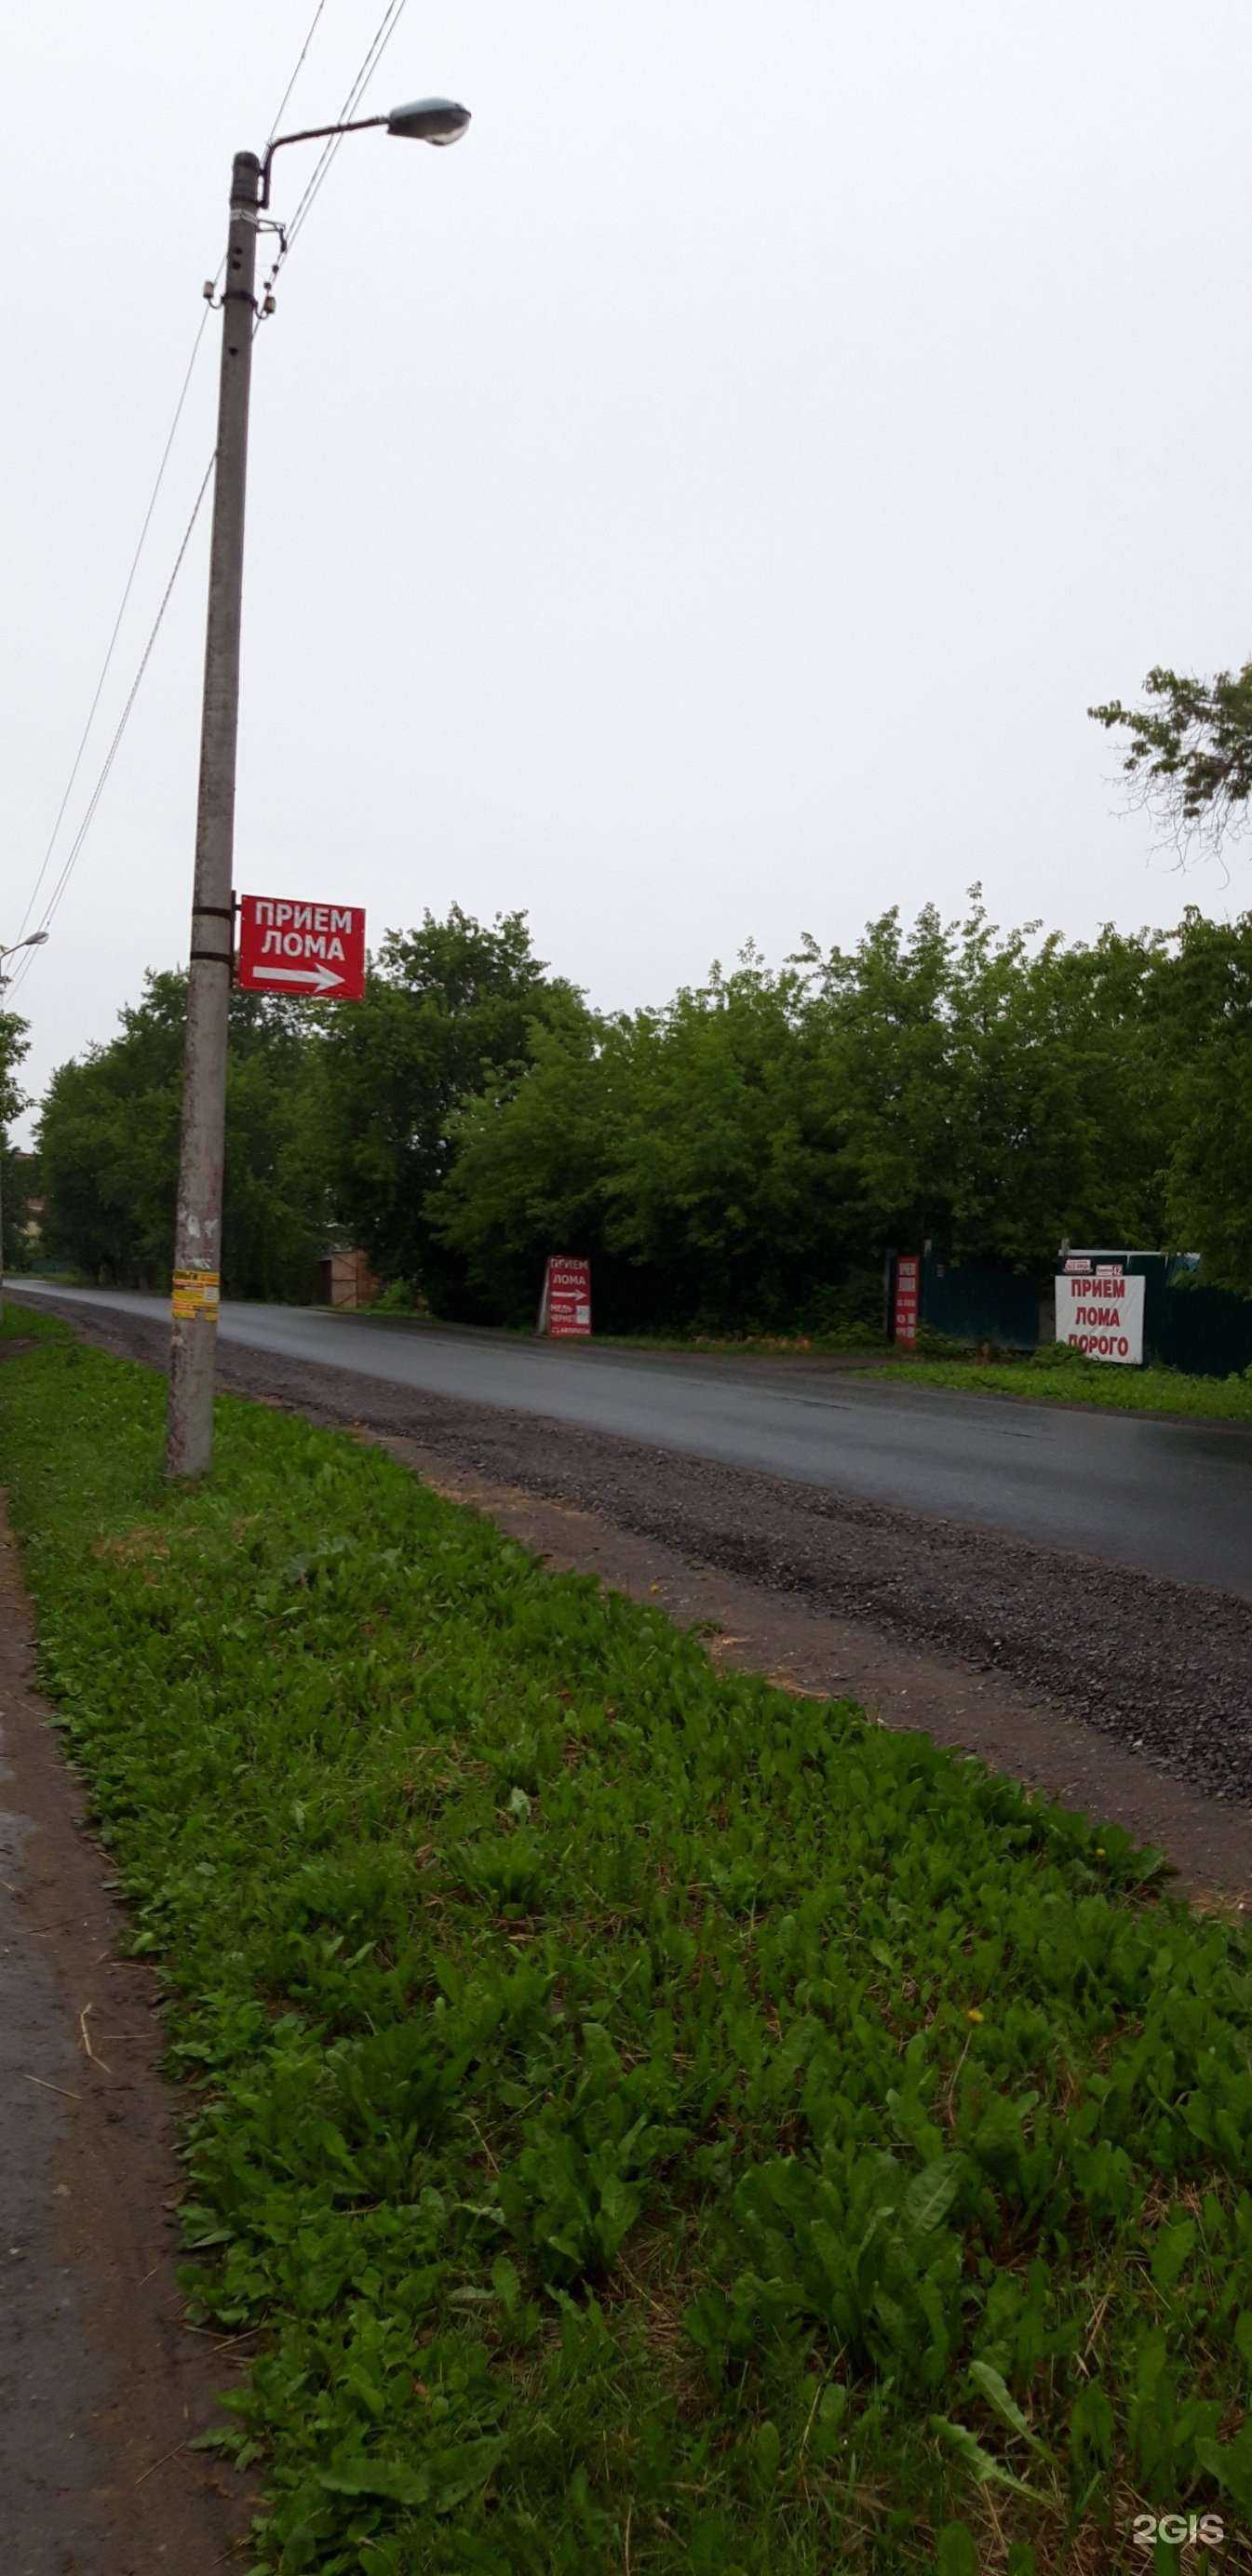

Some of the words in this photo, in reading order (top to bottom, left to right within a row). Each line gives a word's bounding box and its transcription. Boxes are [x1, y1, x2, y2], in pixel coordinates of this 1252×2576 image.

[255, 901, 352, 934] ПРИЕМ
[261, 931, 345, 961] ЛОМА
[551, 1258, 588, 1269] ПРИЕМ
[553, 1274, 586, 1285] ЛОМА
[1070, 1279, 1125, 1298] ПРИЕМ
[1075, 1307, 1120, 1326] ЛОМА
